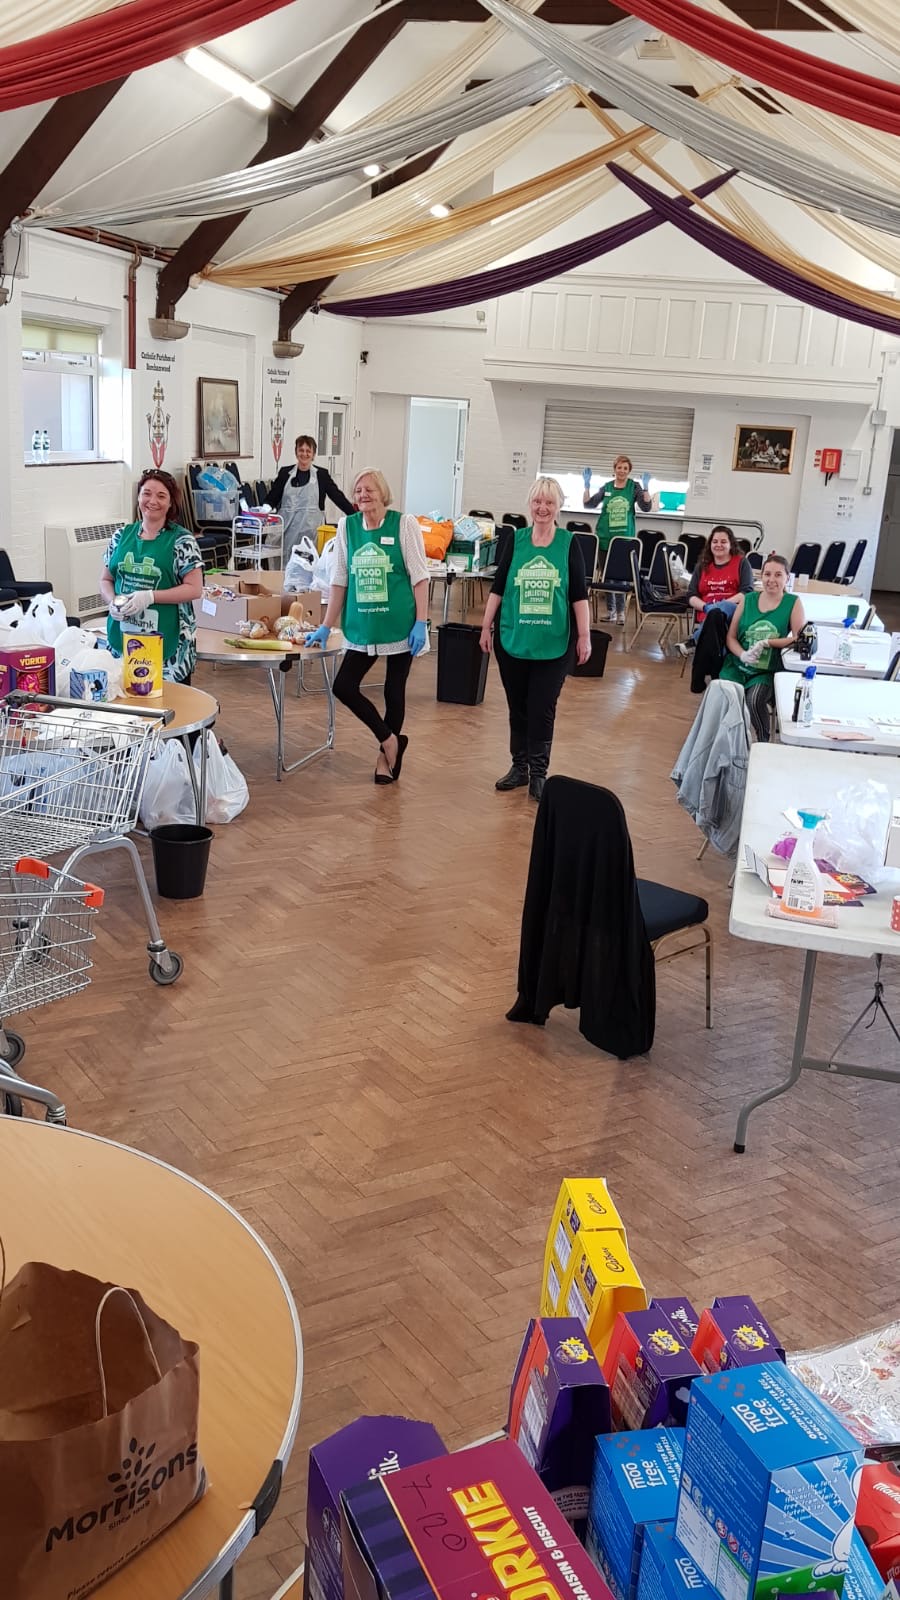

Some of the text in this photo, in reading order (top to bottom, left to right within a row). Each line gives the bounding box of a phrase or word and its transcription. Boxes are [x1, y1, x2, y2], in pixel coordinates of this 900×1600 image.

[358, 568, 382, 577] FOOD
[524, 580, 550, 589] FOOD
[19, 656, 47, 666] YORKIE
[736, 1403, 768, 1433] moo
[752, 1398, 786, 1429] free
[758, 1377, 817, 1441] ORIGINAL EASTER EGG
[760, 1371, 828, 1442] CHOCCY CHUM SURPRISE
[378, 1450, 400, 1477] ilk
[625, 1462, 648, 1489] moo
[642, 1460, 660, 1488] free
[45, 1442, 197, 1552] Morrisons
[873, 1482, 900, 1506] Malte
[523, 1506, 558, 1549] BISCUIT
[550, 1549, 565, 1561] &
[680, 1557, 704, 1588] moo
